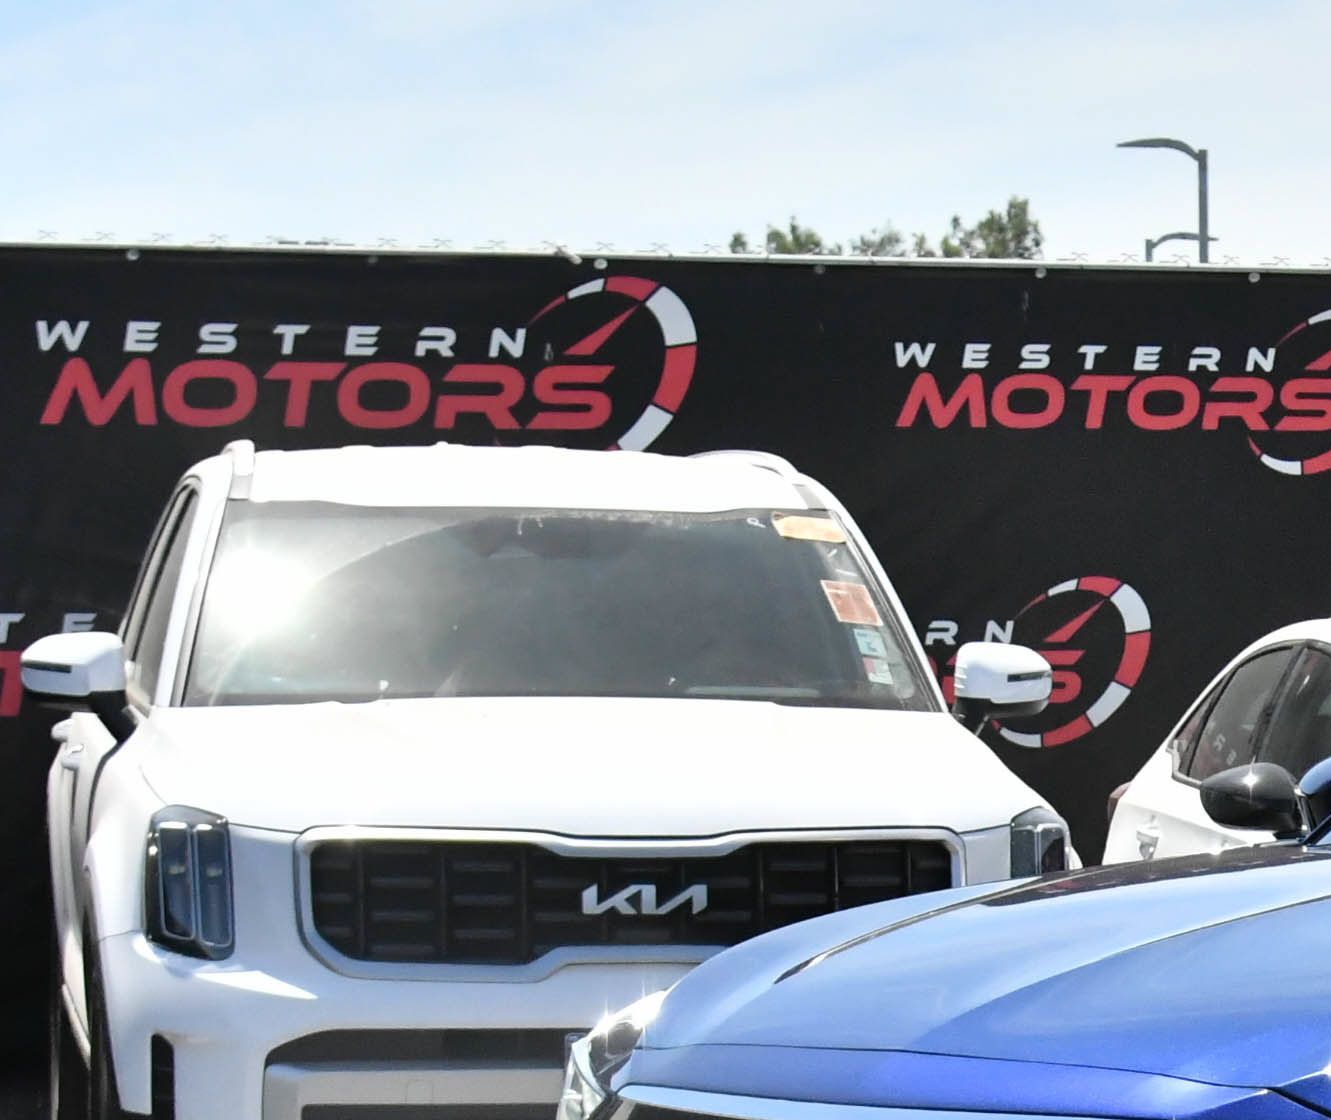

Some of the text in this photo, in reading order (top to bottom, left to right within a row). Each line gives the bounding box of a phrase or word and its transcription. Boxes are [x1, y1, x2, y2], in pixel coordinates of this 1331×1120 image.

[35, 320, 527, 358] WESTERN
[894, 342, 1277, 373] WESTERN
[39, 358, 616, 430] MOTORS
[581, 883, 708, 915] KIA
